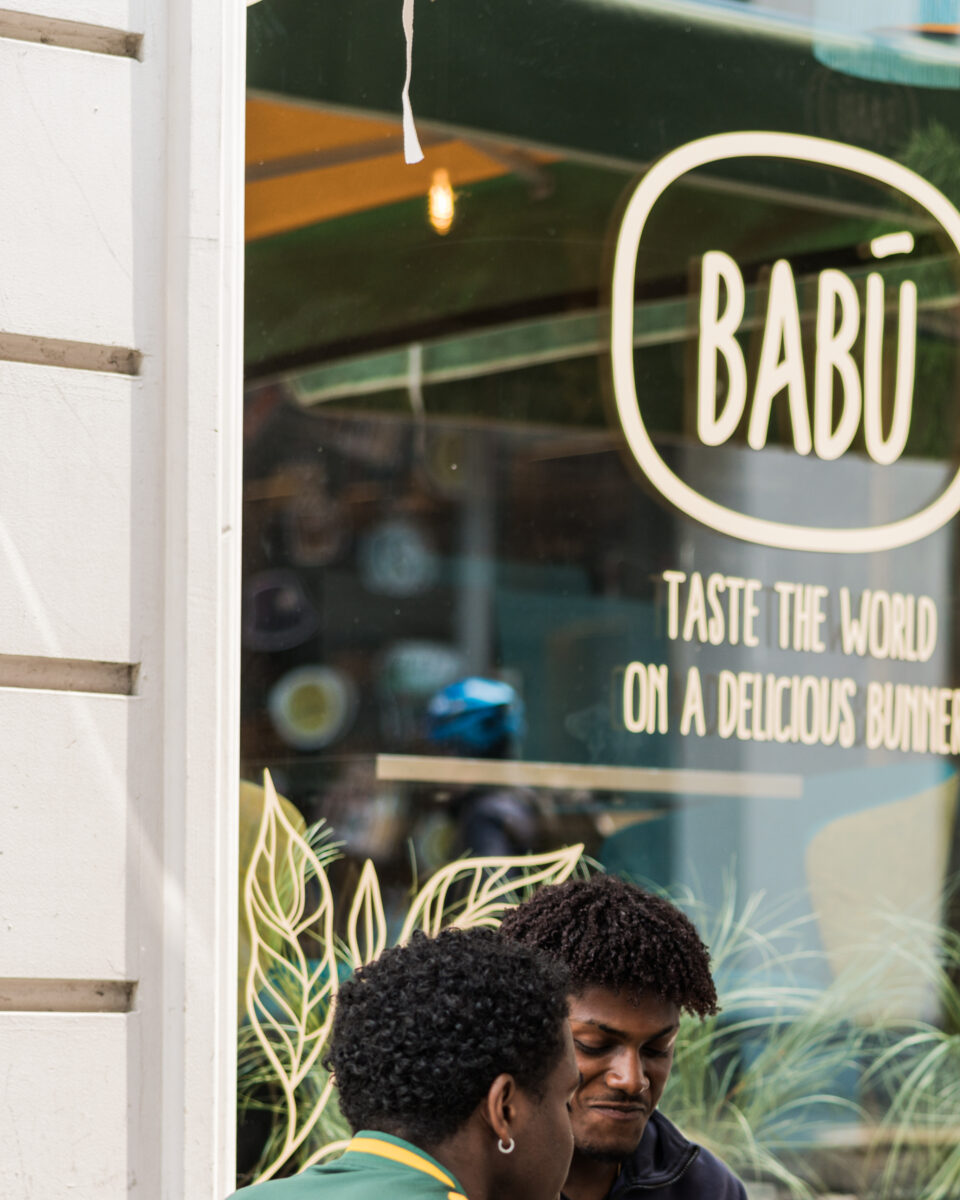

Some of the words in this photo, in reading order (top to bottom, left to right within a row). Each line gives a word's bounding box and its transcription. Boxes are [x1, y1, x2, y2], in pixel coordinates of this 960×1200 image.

[662, 570, 762, 647] TASTE
[774, 581, 828, 653] THE
[839, 586, 938, 663] WORLD
[623, 661, 668, 735] ON
[680, 666, 706, 737] A
[718, 670, 857, 749] DELICIOUS
